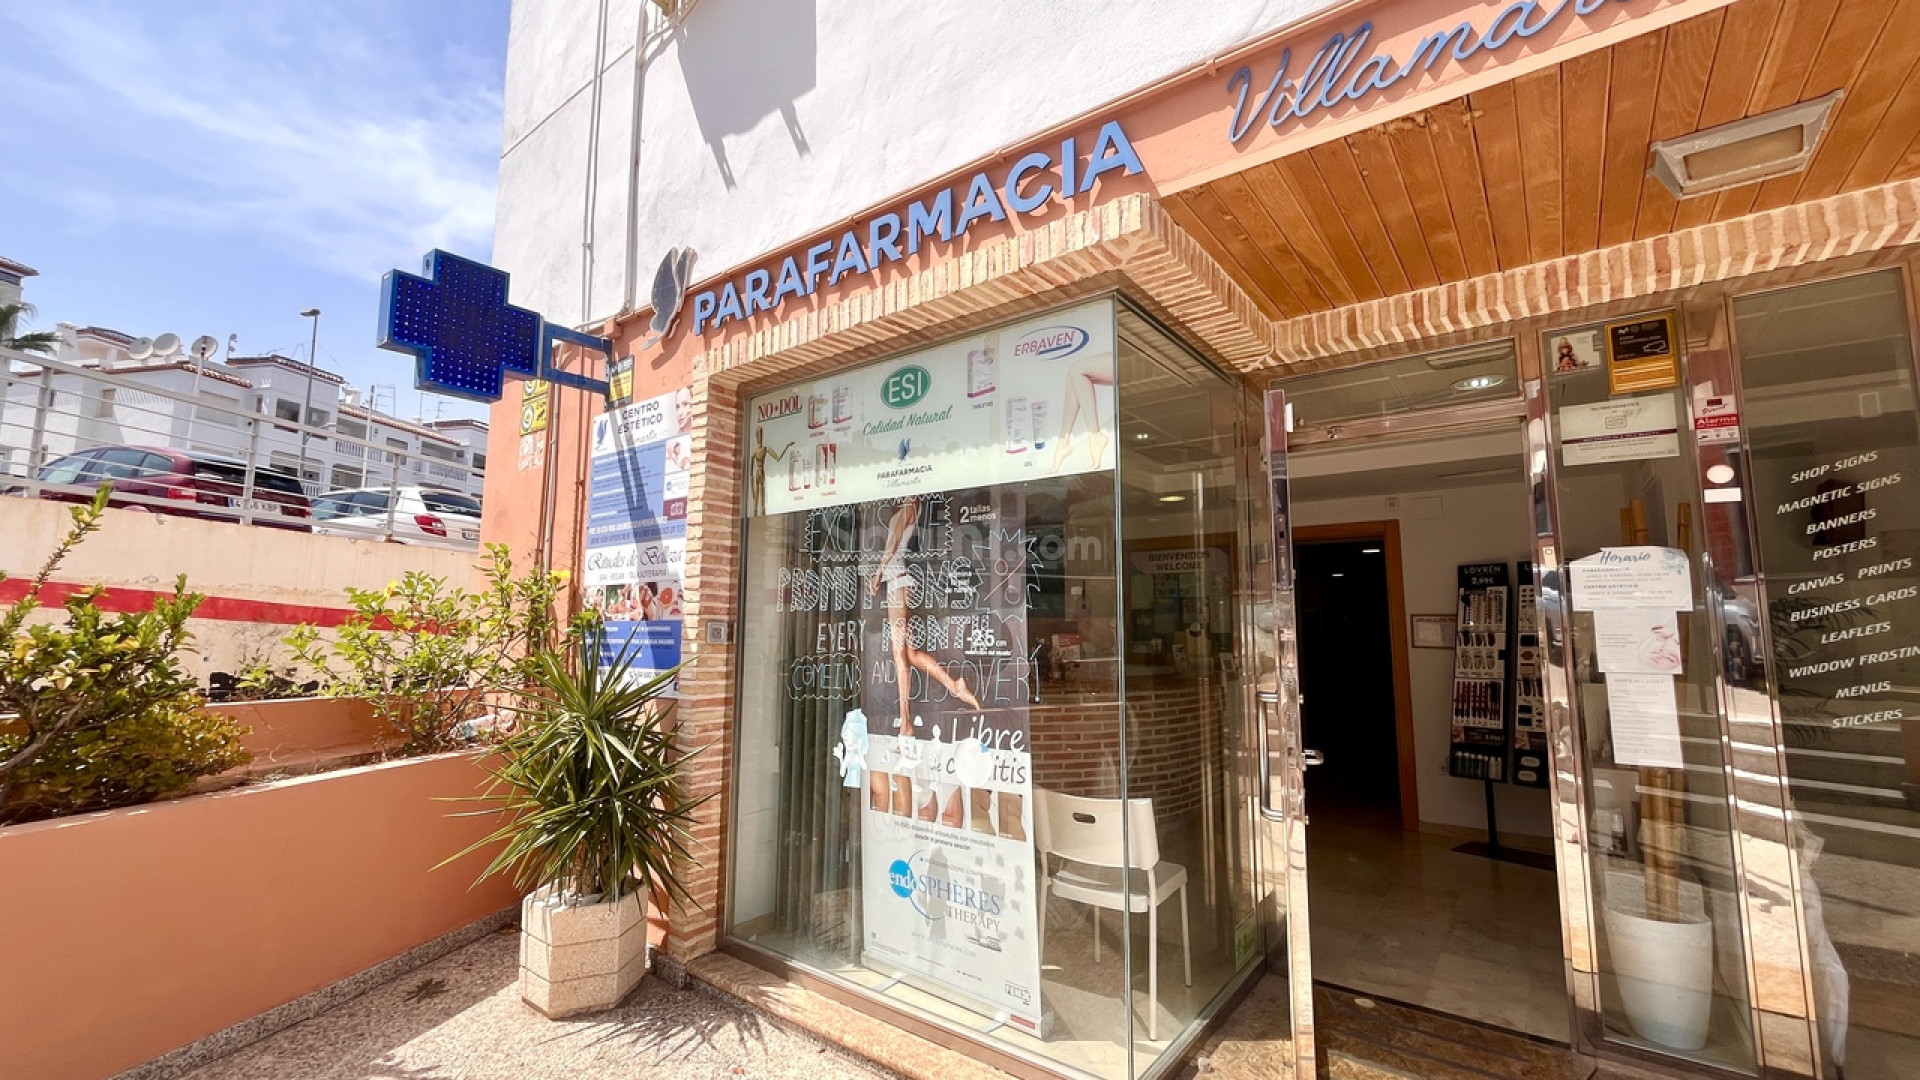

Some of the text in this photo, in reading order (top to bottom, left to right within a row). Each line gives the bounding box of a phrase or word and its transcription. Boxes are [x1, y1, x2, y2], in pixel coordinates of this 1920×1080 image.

[694, 120, 1144, 336] PARAFARMACIA
[1013, 331, 1075, 357] ERBAVEN
[888, 371, 924, 403] ESI
[622, 401, 659, 420] CENTRO
[863, 405, 953, 437] Calidad Natural
[876, 465, 933, 480] PARAFARMACIA
[1790, 450, 1878, 484] SHOP SIGNS
[1776, 472, 1902, 515] MAGNETIC SIGNS
[959, 506, 970, 522] 2
[1805, 508, 1877, 535] BANNERS
[1148, 551, 1210, 562] BIENVENIDOS
[1600, 551, 1651, 564] Horario
[1812, 537, 1878, 561] POSTERS
[1156, 561, 1203, 571] WELCOME
[1787, 558, 1912, 594] CANVAS PRINTS
[777, 556, 973, 612] PROMOTIONS
[1790, 586, 1918, 621] BUSINESS CARDS
[816, 614, 990, 653] EVERY MONTH
[1820, 621, 1891, 644] LEAFLETS
[871, 659, 897, 685] AND
[1788, 657, 1855, 678] WINDOW
[1835, 680, 1891, 699] MENUS
[1832, 708, 1902, 729] STICKERS
[951, 714, 1026, 752] Libre
[946, 904, 1002, 932] THERAPY
